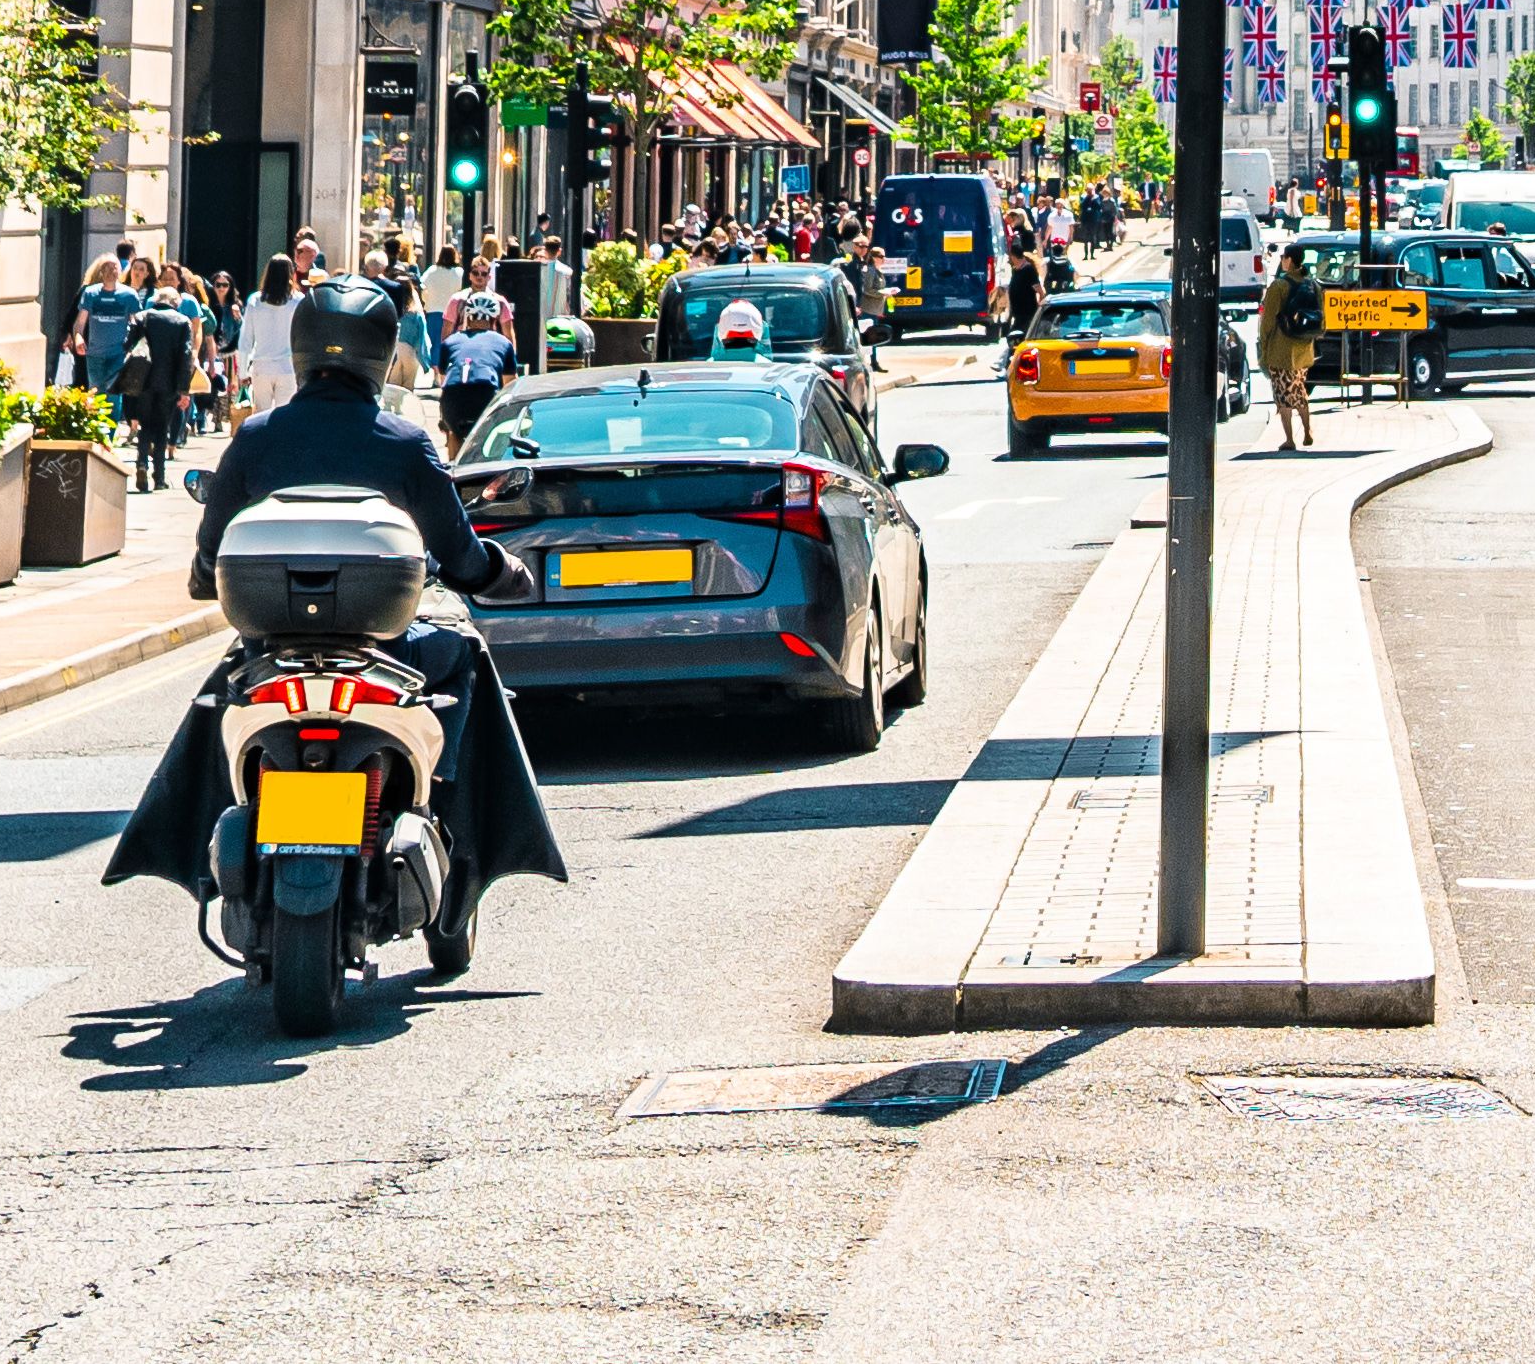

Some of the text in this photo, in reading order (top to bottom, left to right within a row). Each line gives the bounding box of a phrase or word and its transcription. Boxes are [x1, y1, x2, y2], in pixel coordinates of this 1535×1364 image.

[881, 51, 906, 61] HUGO
[367, 87, 414, 95] COACH
[1329, 296, 1388, 309] Diverted
[1337, 310, 1381, 322] traffic
